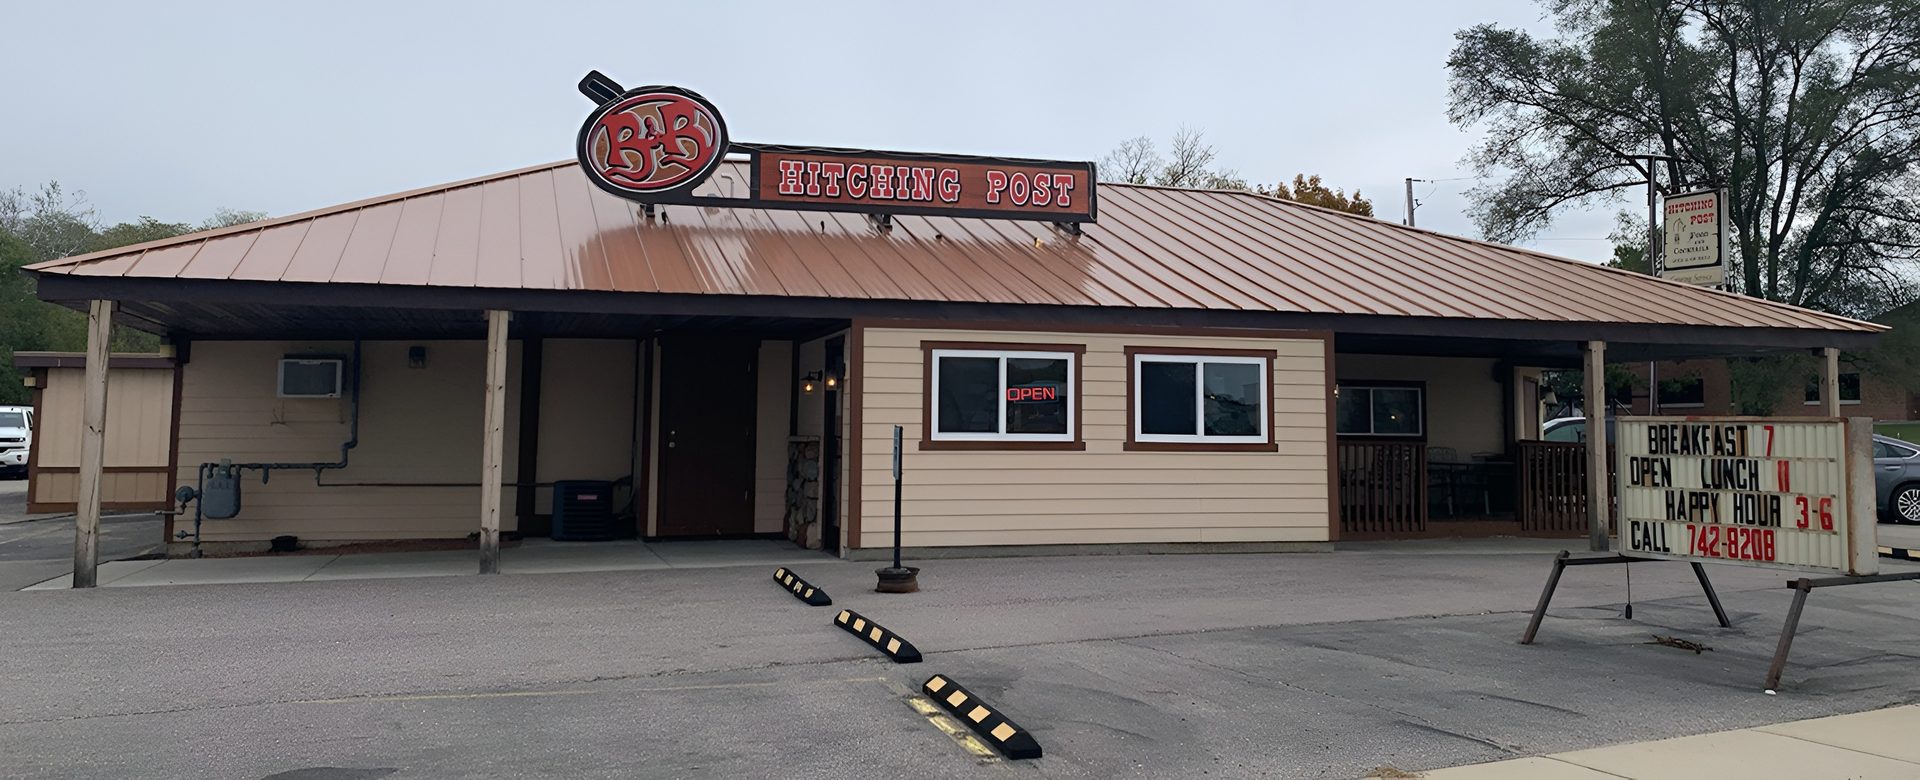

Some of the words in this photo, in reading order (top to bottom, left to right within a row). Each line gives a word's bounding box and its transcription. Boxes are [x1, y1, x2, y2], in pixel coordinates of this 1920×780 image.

[599, 100, 716, 182] B&B
[777, 160, 961, 202] HITCHING
[986, 170, 1074, 207] POST
[1667, 199, 1714, 215] HITCHING
[1690, 213, 1715, 226] POST
[1007, 387, 1055, 401] OPEN
[1648, 424, 1748, 456] BREAKFAST
[1763, 425, 1775, 459] 7
[1630, 456, 1672, 488] OPEN
[1701, 458, 1760, 491] LUNCH
[1777, 460, 1790, 492] 11
[1665, 490, 1721, 523] HAPPY
[1733, 493, 1782, 527] HOUR
[1796, 496, 1834, 530] 3-6
[1631, 520, 1670, 552] CALL
[1686, 524, 1776, 561] 742-8208
